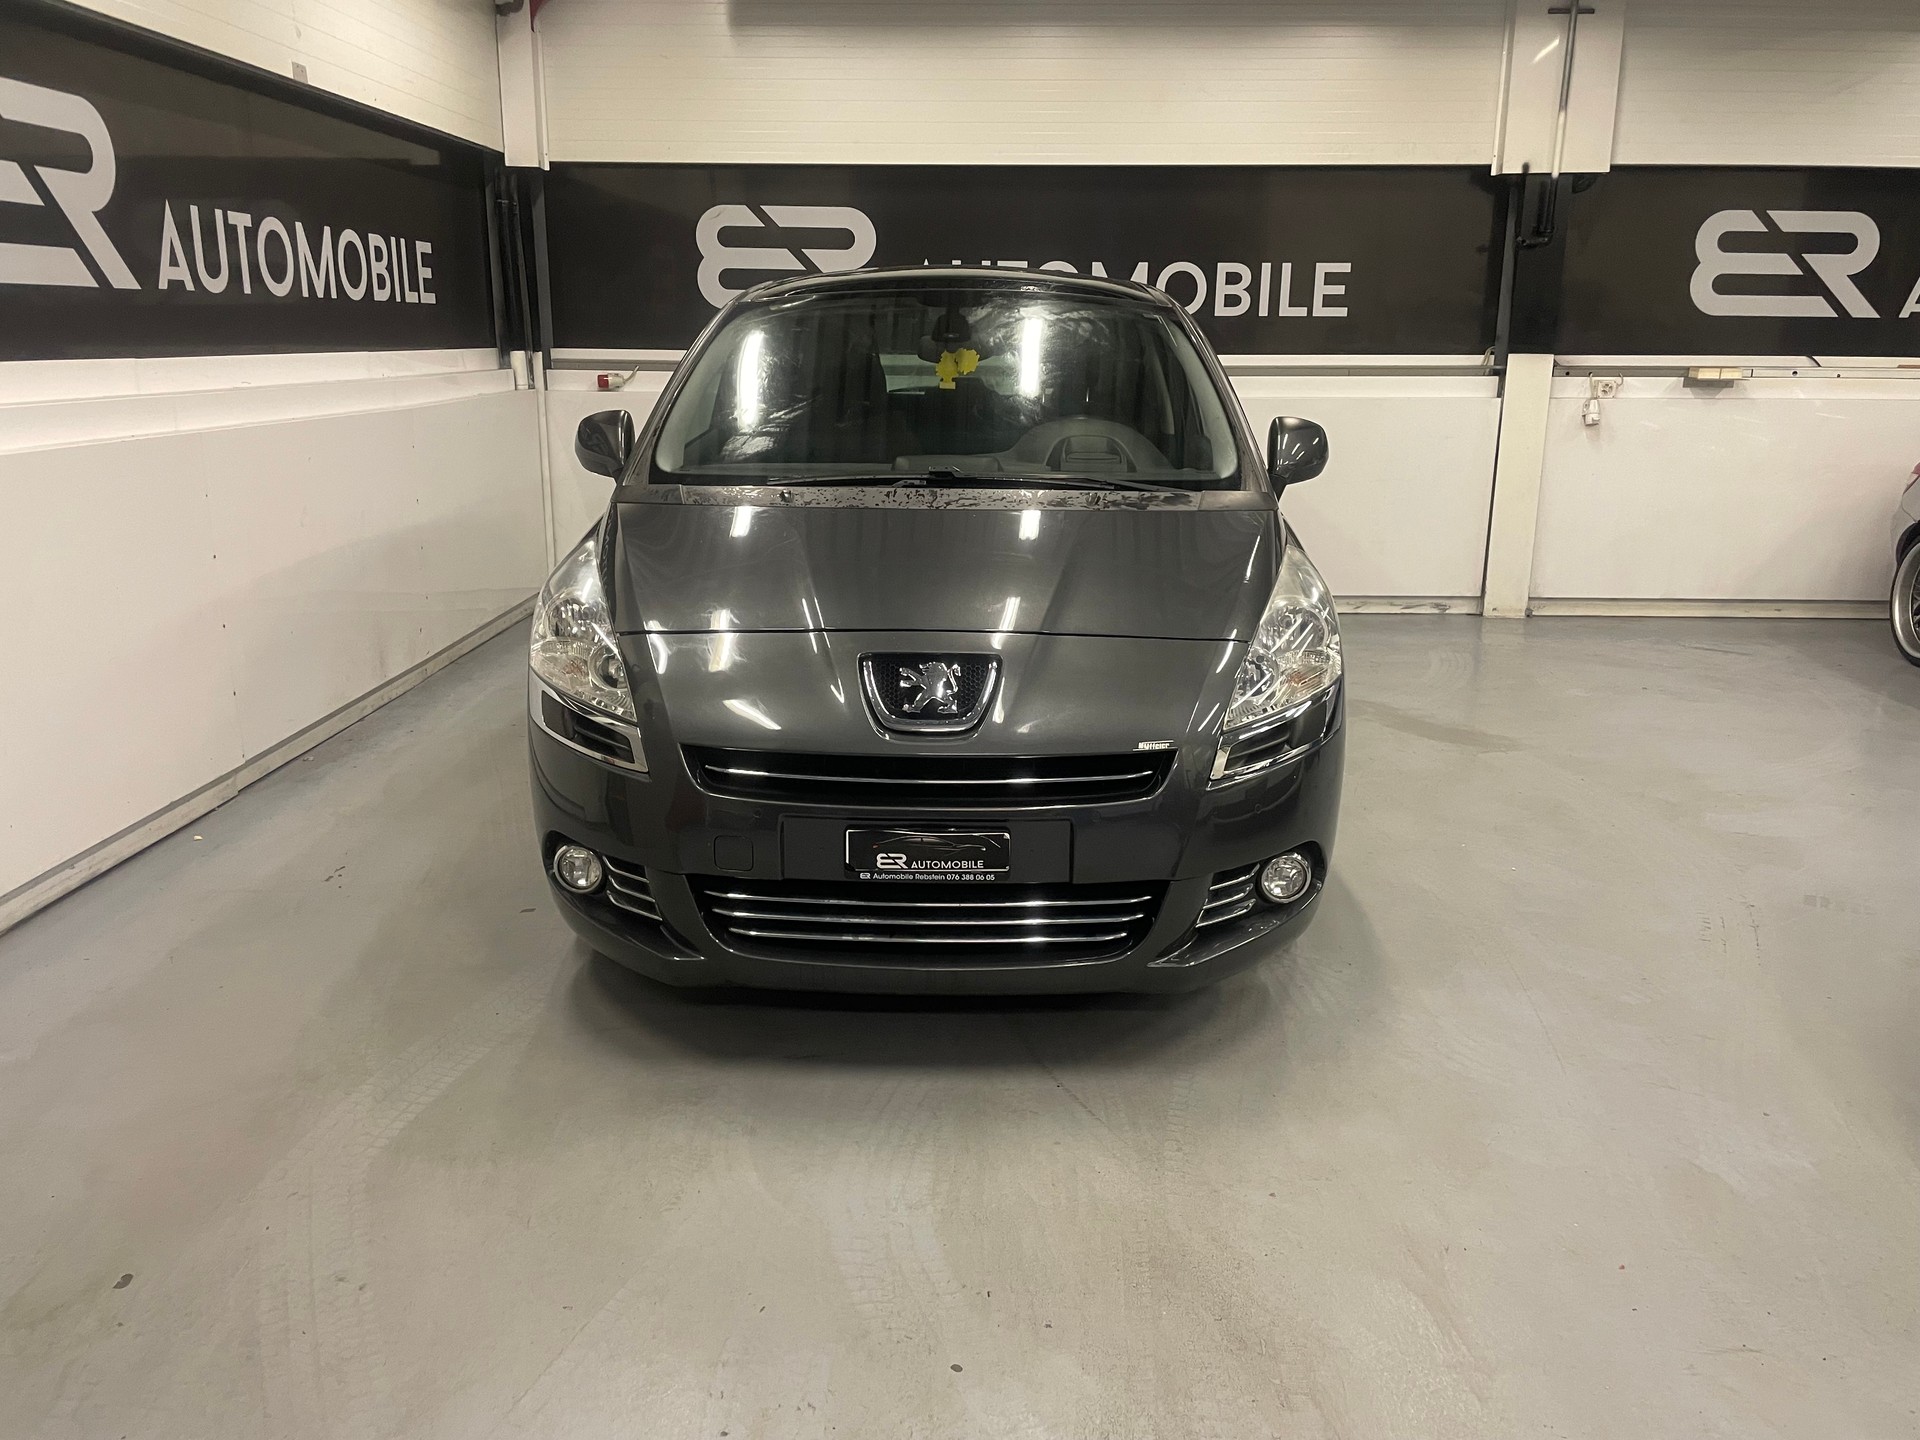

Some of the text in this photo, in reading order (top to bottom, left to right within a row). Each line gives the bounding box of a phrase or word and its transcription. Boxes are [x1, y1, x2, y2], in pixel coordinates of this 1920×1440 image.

[158, 199, 437, 305] AUTOMOBILE
[1689, 209, 1881, 319] ER
[876, 853, 984, 869] ER AUTOMOBILE
